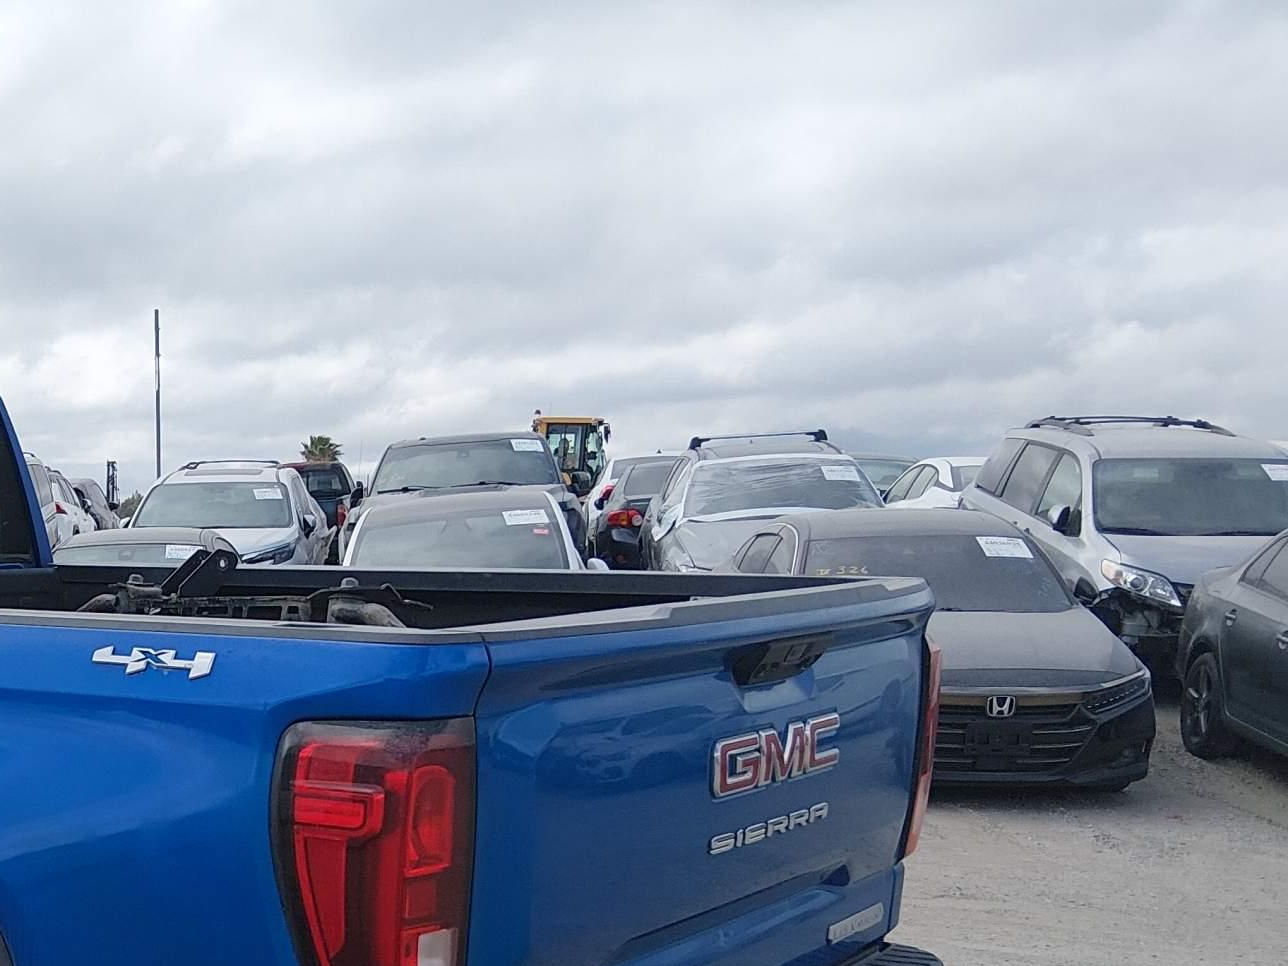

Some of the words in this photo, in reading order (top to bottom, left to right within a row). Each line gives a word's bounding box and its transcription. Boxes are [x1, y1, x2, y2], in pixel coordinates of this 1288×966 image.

[836, 565, 868, 575] 326
[713, 712, 840, 798] GMC
[710, 802, 829, 855] SIERRA
